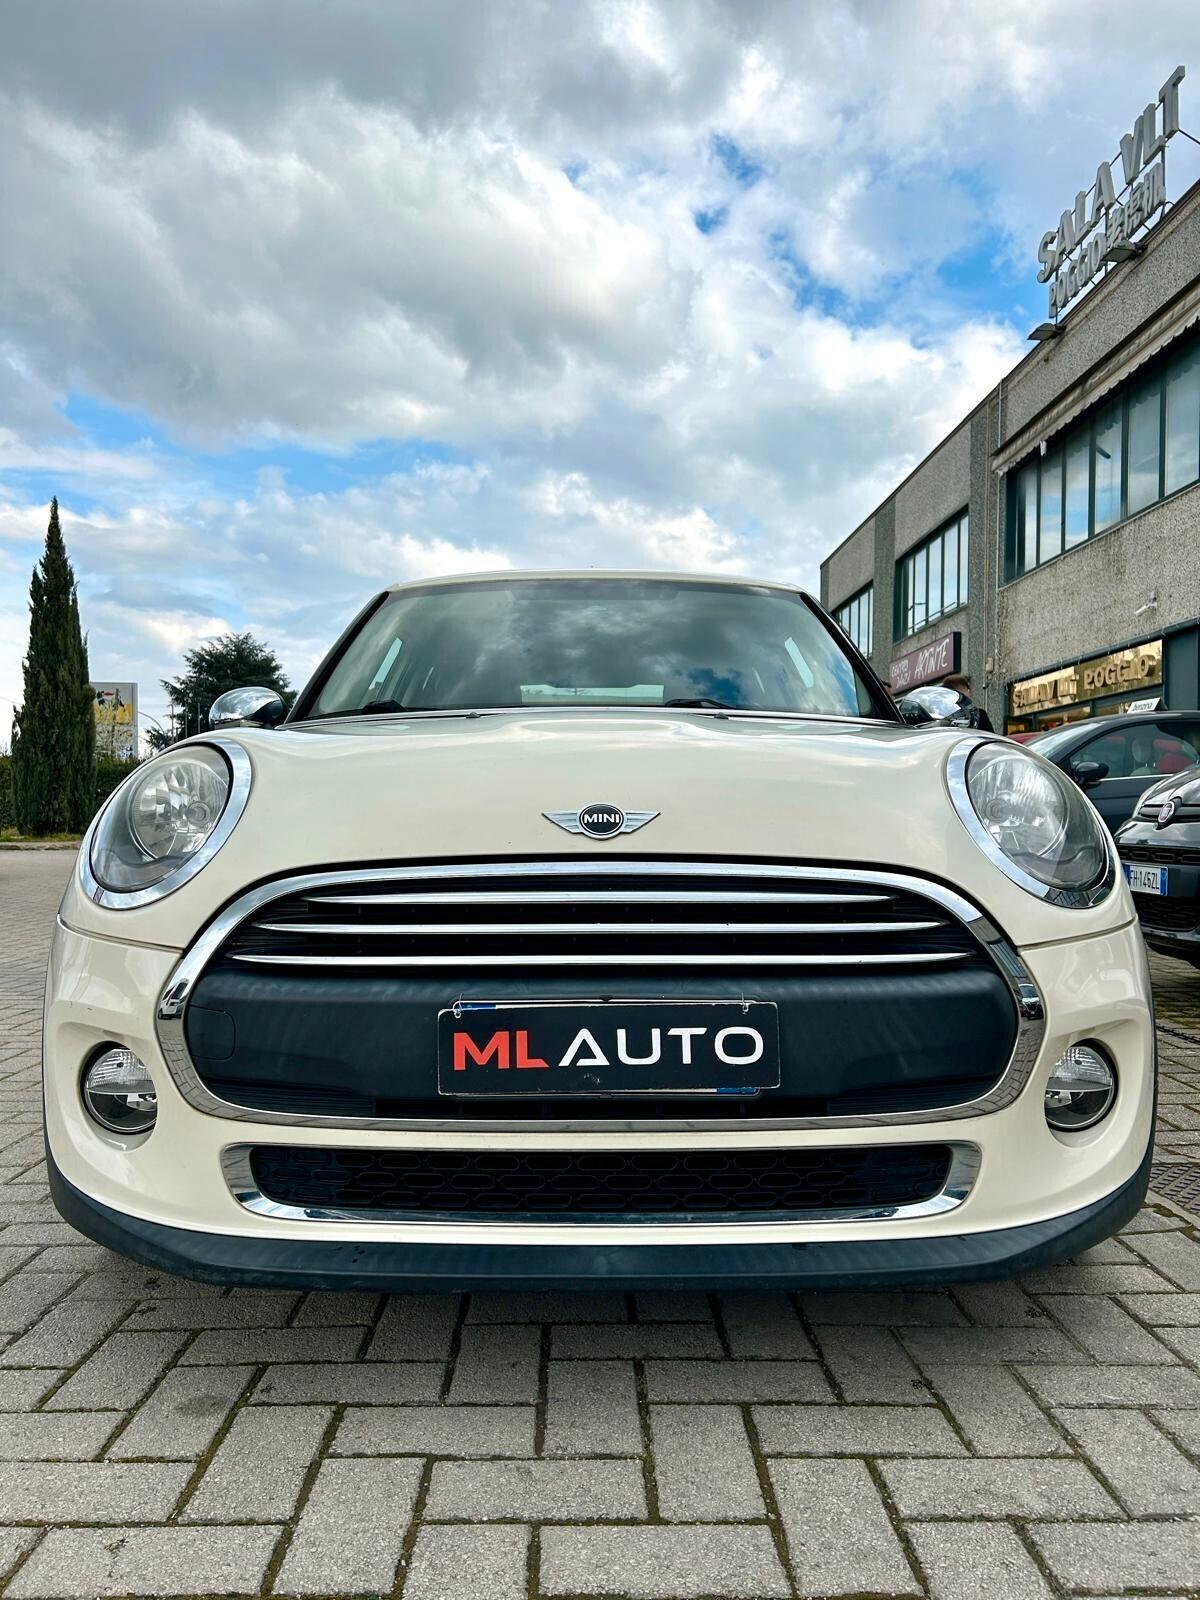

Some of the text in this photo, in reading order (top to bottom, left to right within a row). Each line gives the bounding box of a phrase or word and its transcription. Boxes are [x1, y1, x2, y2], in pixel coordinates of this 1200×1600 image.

[1037, 65, 1185, 283] SALA VLT
[1048, 233, 1107, 318] POGGIO
[1013, 683, 1048, 707] SALA
[1084, 656, 1152, 690] POGGIO
[583, 813, 620, 823] MINI
[453, 1026, 764, 1071] ML AUTO
